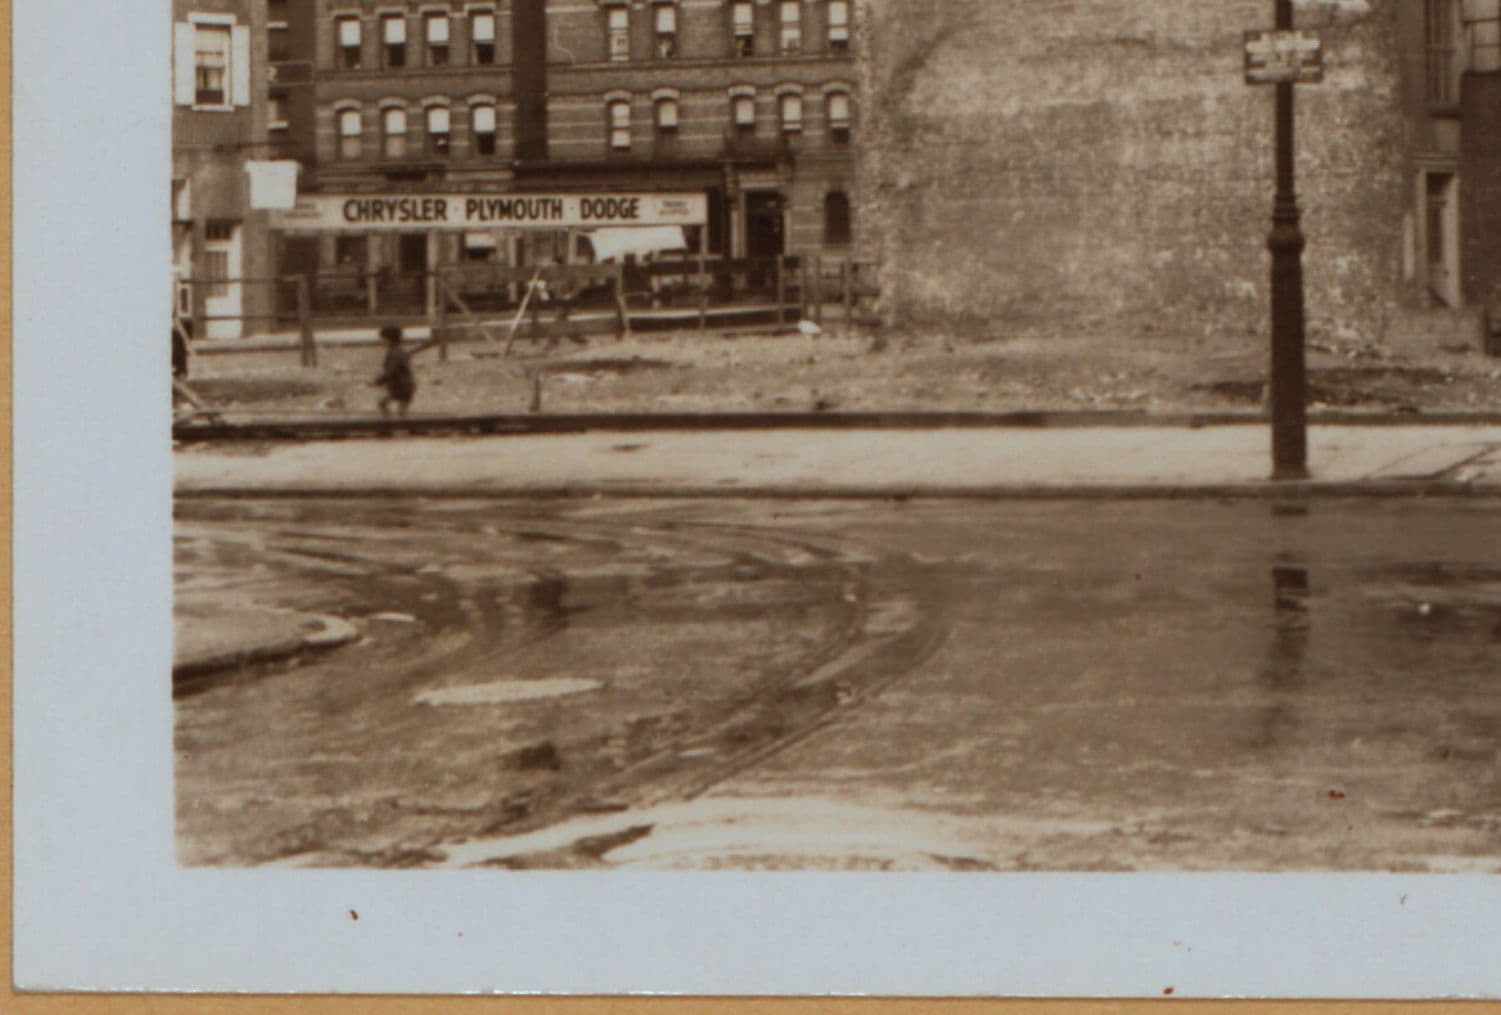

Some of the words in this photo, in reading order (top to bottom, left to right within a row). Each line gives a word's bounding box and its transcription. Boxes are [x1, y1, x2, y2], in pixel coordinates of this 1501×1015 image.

[342, 198, 448, 223] CHRYSLER
[465, 197, 564, 221] PLYMOUTH
[579, 197, 640, 220] DODGE
